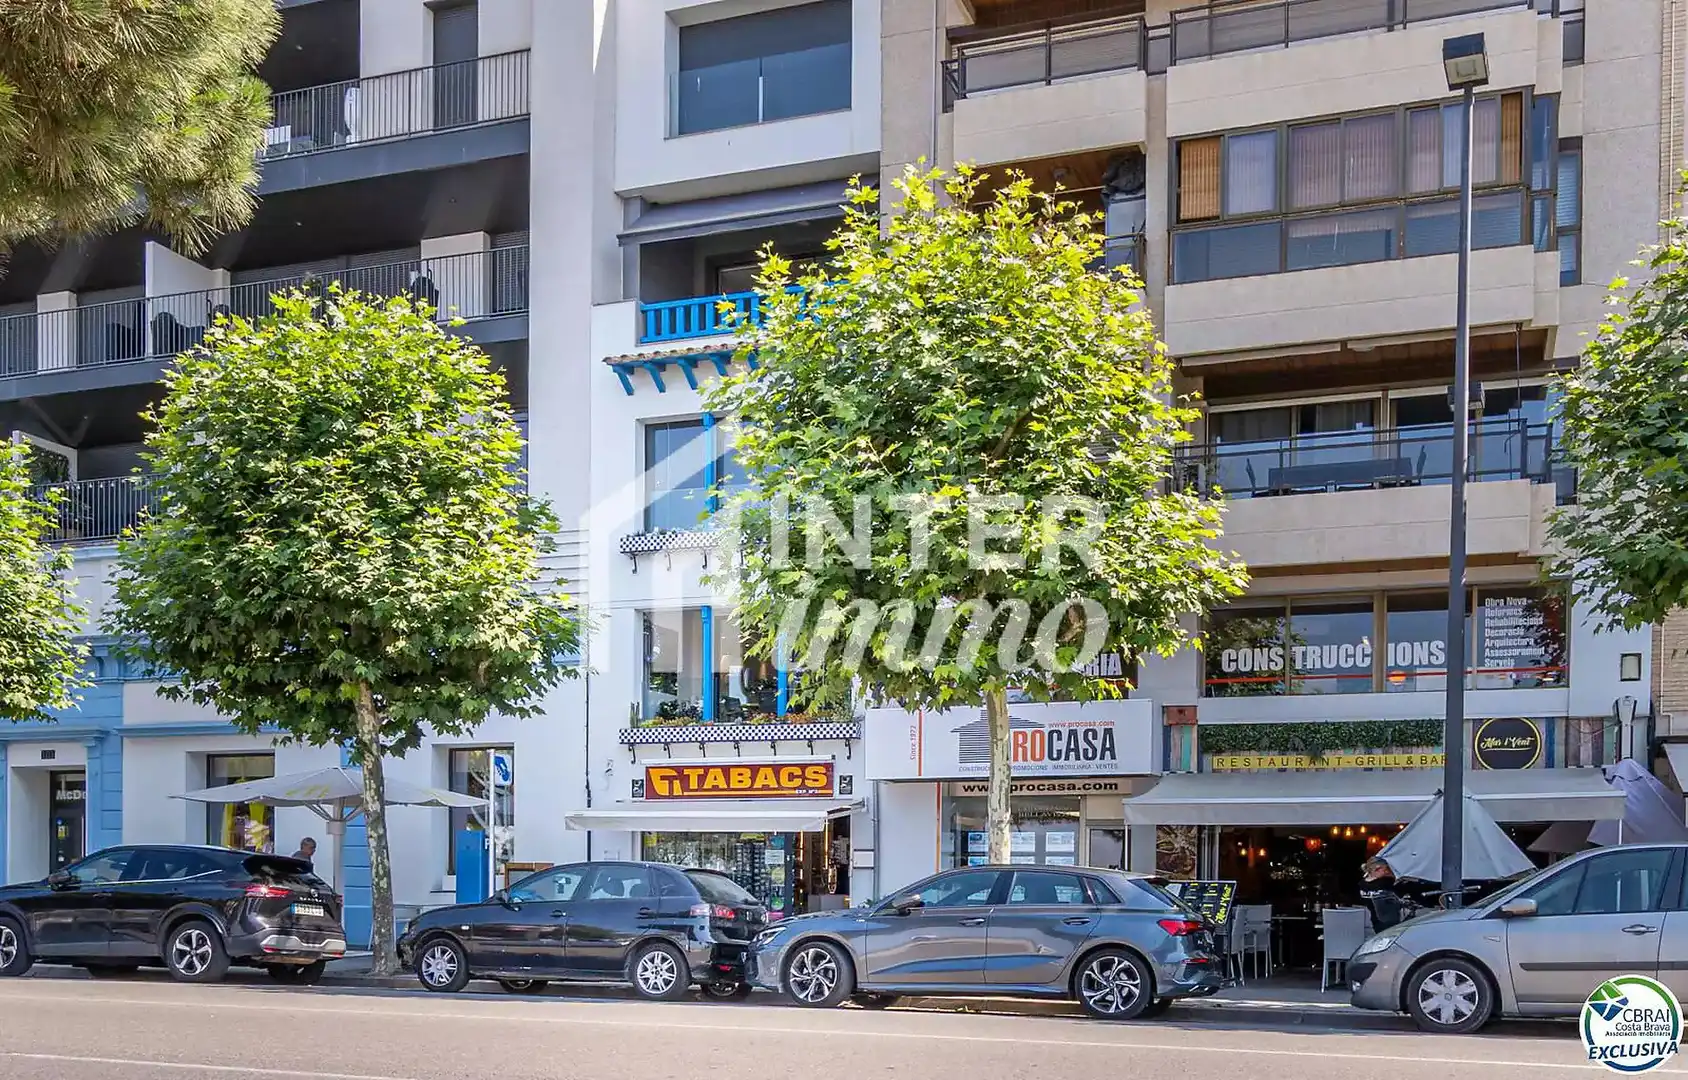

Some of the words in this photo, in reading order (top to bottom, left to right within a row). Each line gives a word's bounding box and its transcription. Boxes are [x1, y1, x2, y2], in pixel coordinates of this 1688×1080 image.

[1485, 597, 1504, 607] Obra
[1506, 596, 1527, 606] Nova
[1012, 728, 1117, 762] ROCASA
[683, 766, 828, 789] TABACS
[963, 782, 1118, 794] wwprocasa.com
